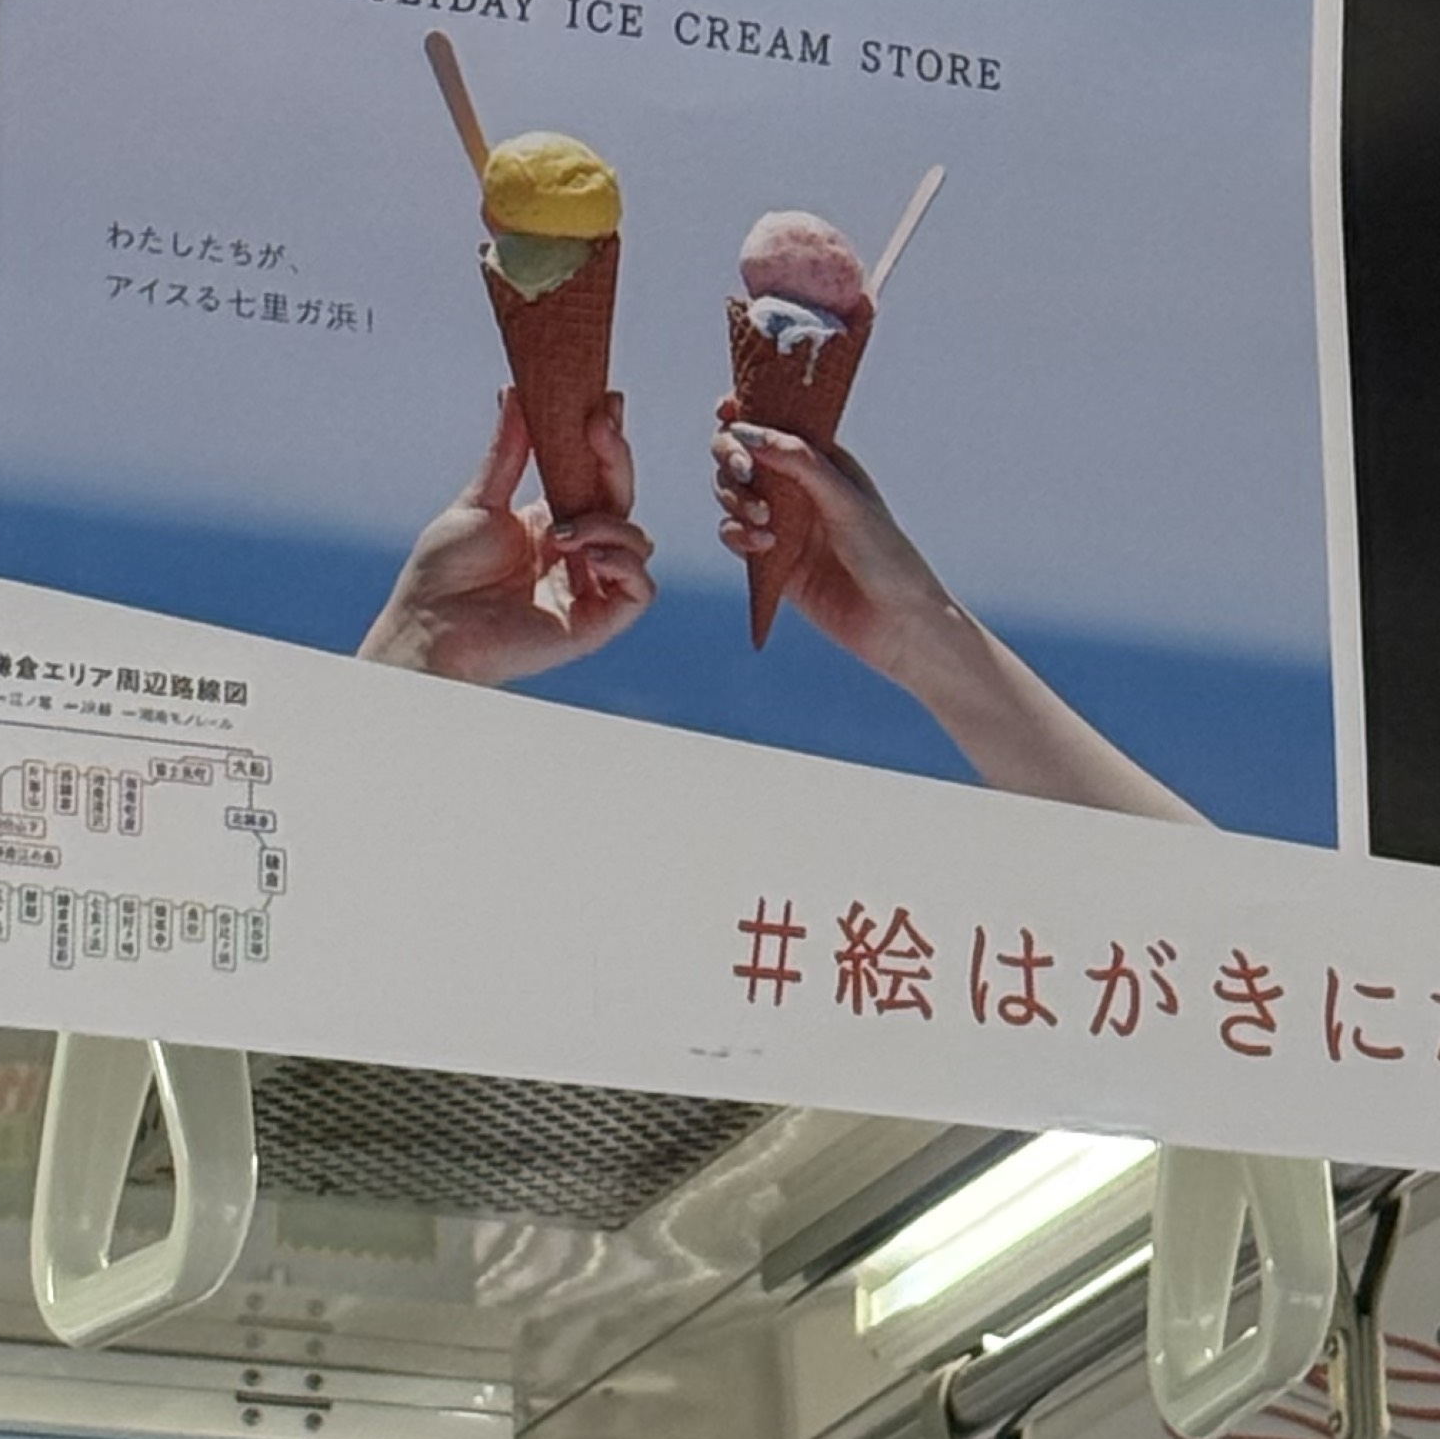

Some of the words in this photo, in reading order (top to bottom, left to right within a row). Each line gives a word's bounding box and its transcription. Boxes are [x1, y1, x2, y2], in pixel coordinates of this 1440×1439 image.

[674, 11, 832, 66] CREAM
[860, 41, 1002, 92] STORE
[107, 221, 298, 274] わたしたちが、
